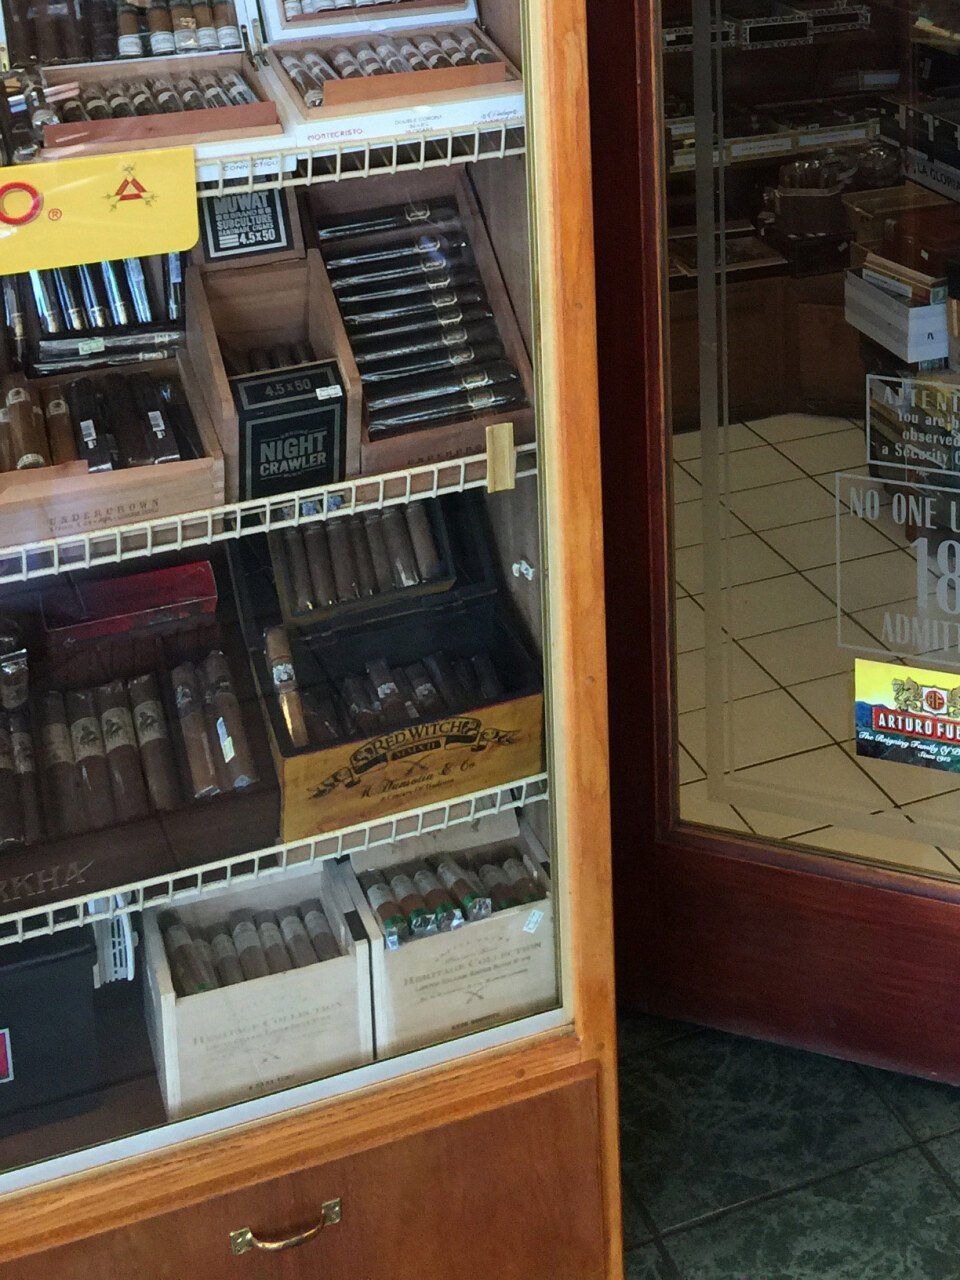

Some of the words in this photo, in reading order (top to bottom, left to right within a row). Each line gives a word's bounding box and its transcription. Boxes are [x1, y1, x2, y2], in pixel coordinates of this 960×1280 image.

[308, 128, 364, 142] MONTECRISTO
[214, 191, 270, 214] MUWAT
[217, 214, 273, 230] SUBCULTURE
[260, 430, 328, 463] NIGHT
[902, 426, 960, 447] observed
[260, 452, 327, 477] CRAWLER
[850, 486, 880, 521] NO
[892, 493, 938, 530] ONE
[878, 713, 933, 735] ARTURO
[372, 733, 407, 755] RED
[408, 721, 461, 742] WITCH
[858, 731, 874, 741] The
[875, 733, 910, 749] Reigning
[911, 740, 938, 754] Family
[917, 752, 935, 760] Since
